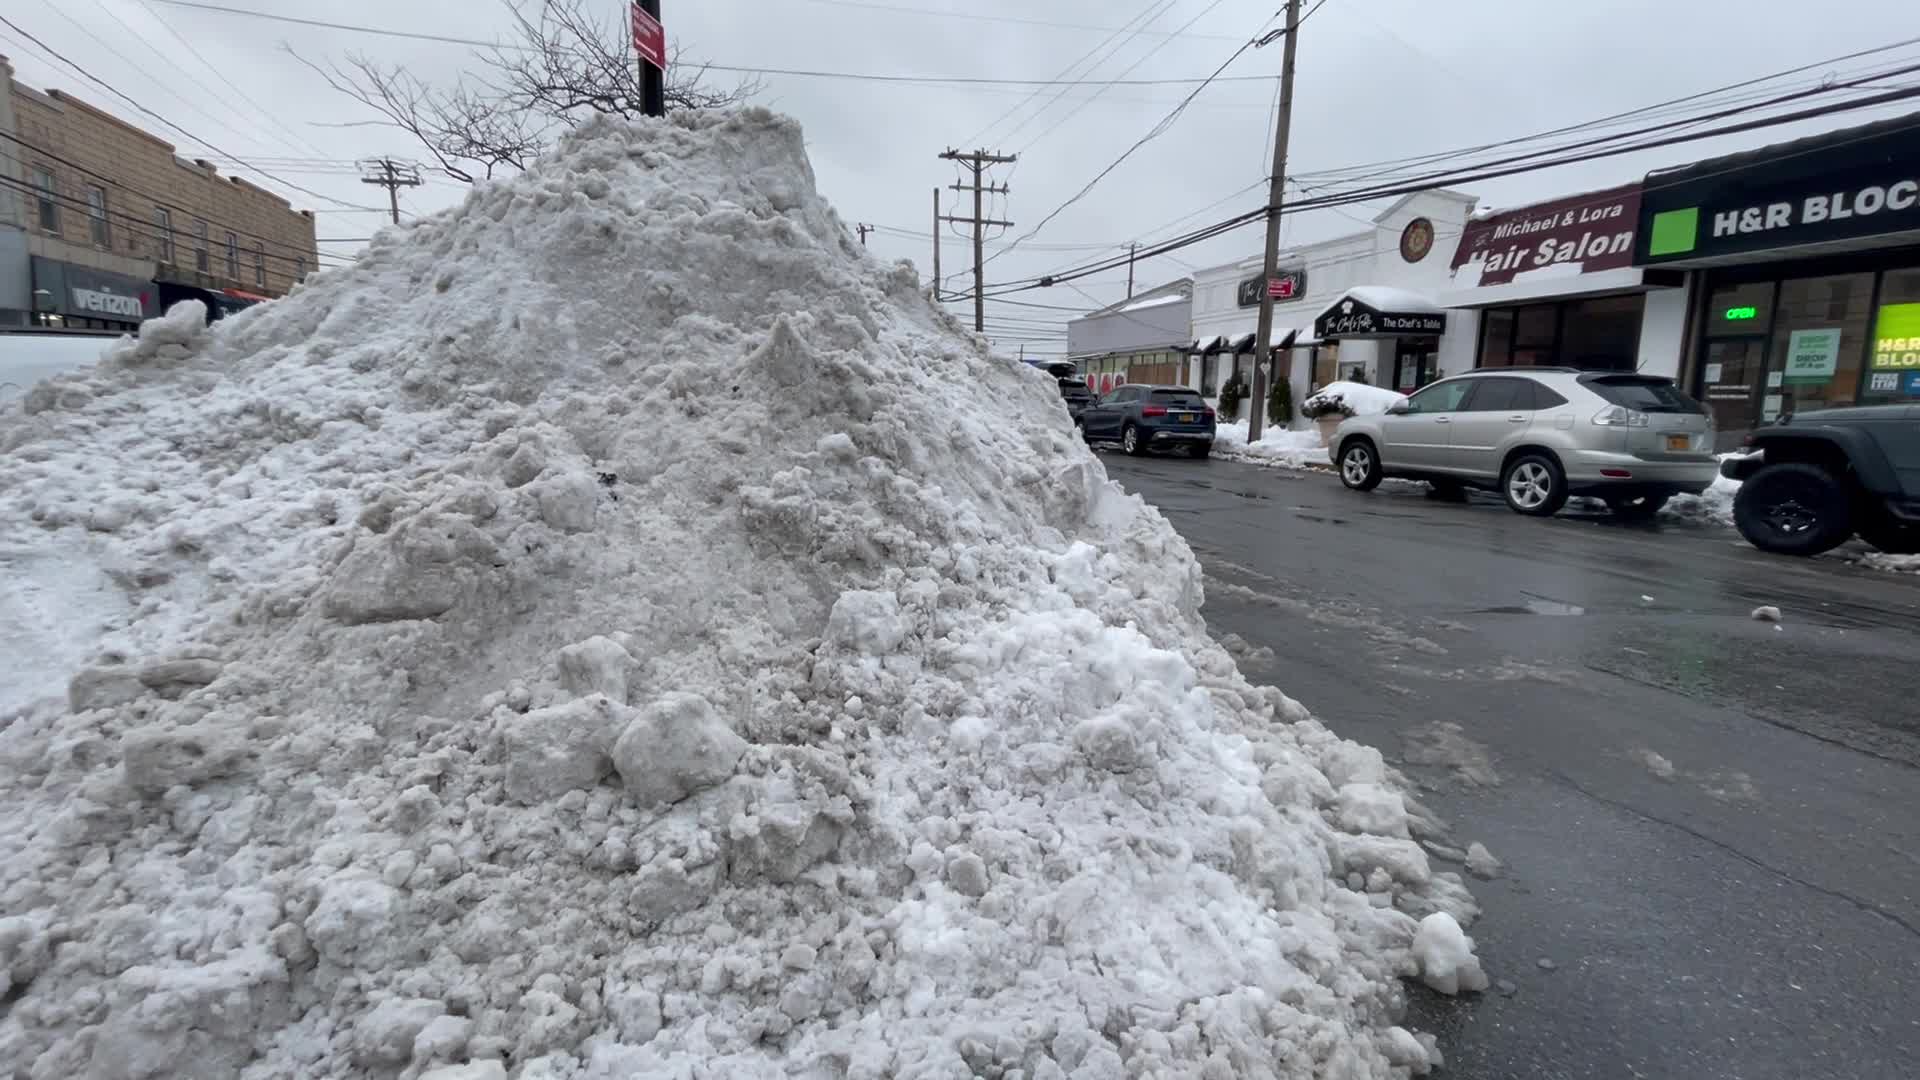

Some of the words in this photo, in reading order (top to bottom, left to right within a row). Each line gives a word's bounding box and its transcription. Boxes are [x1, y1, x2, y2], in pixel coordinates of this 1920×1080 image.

[1491, 214, 1559, 241] Michael
[1561, 211, 1575, 227] &
[1579, 204, 1624, 224] Lora
[1713, 202, 1792, 237] H&R
[1801, 180, 1920, 224] BLOC
[1533, 231, 1633, 266] Salon
[72, 286, 143, 317] verizon
[1726, 307, 1755, 319] OPEN
[1383, 317, 1396, 328] The
[1876, 352, 1920, 367] BLO
